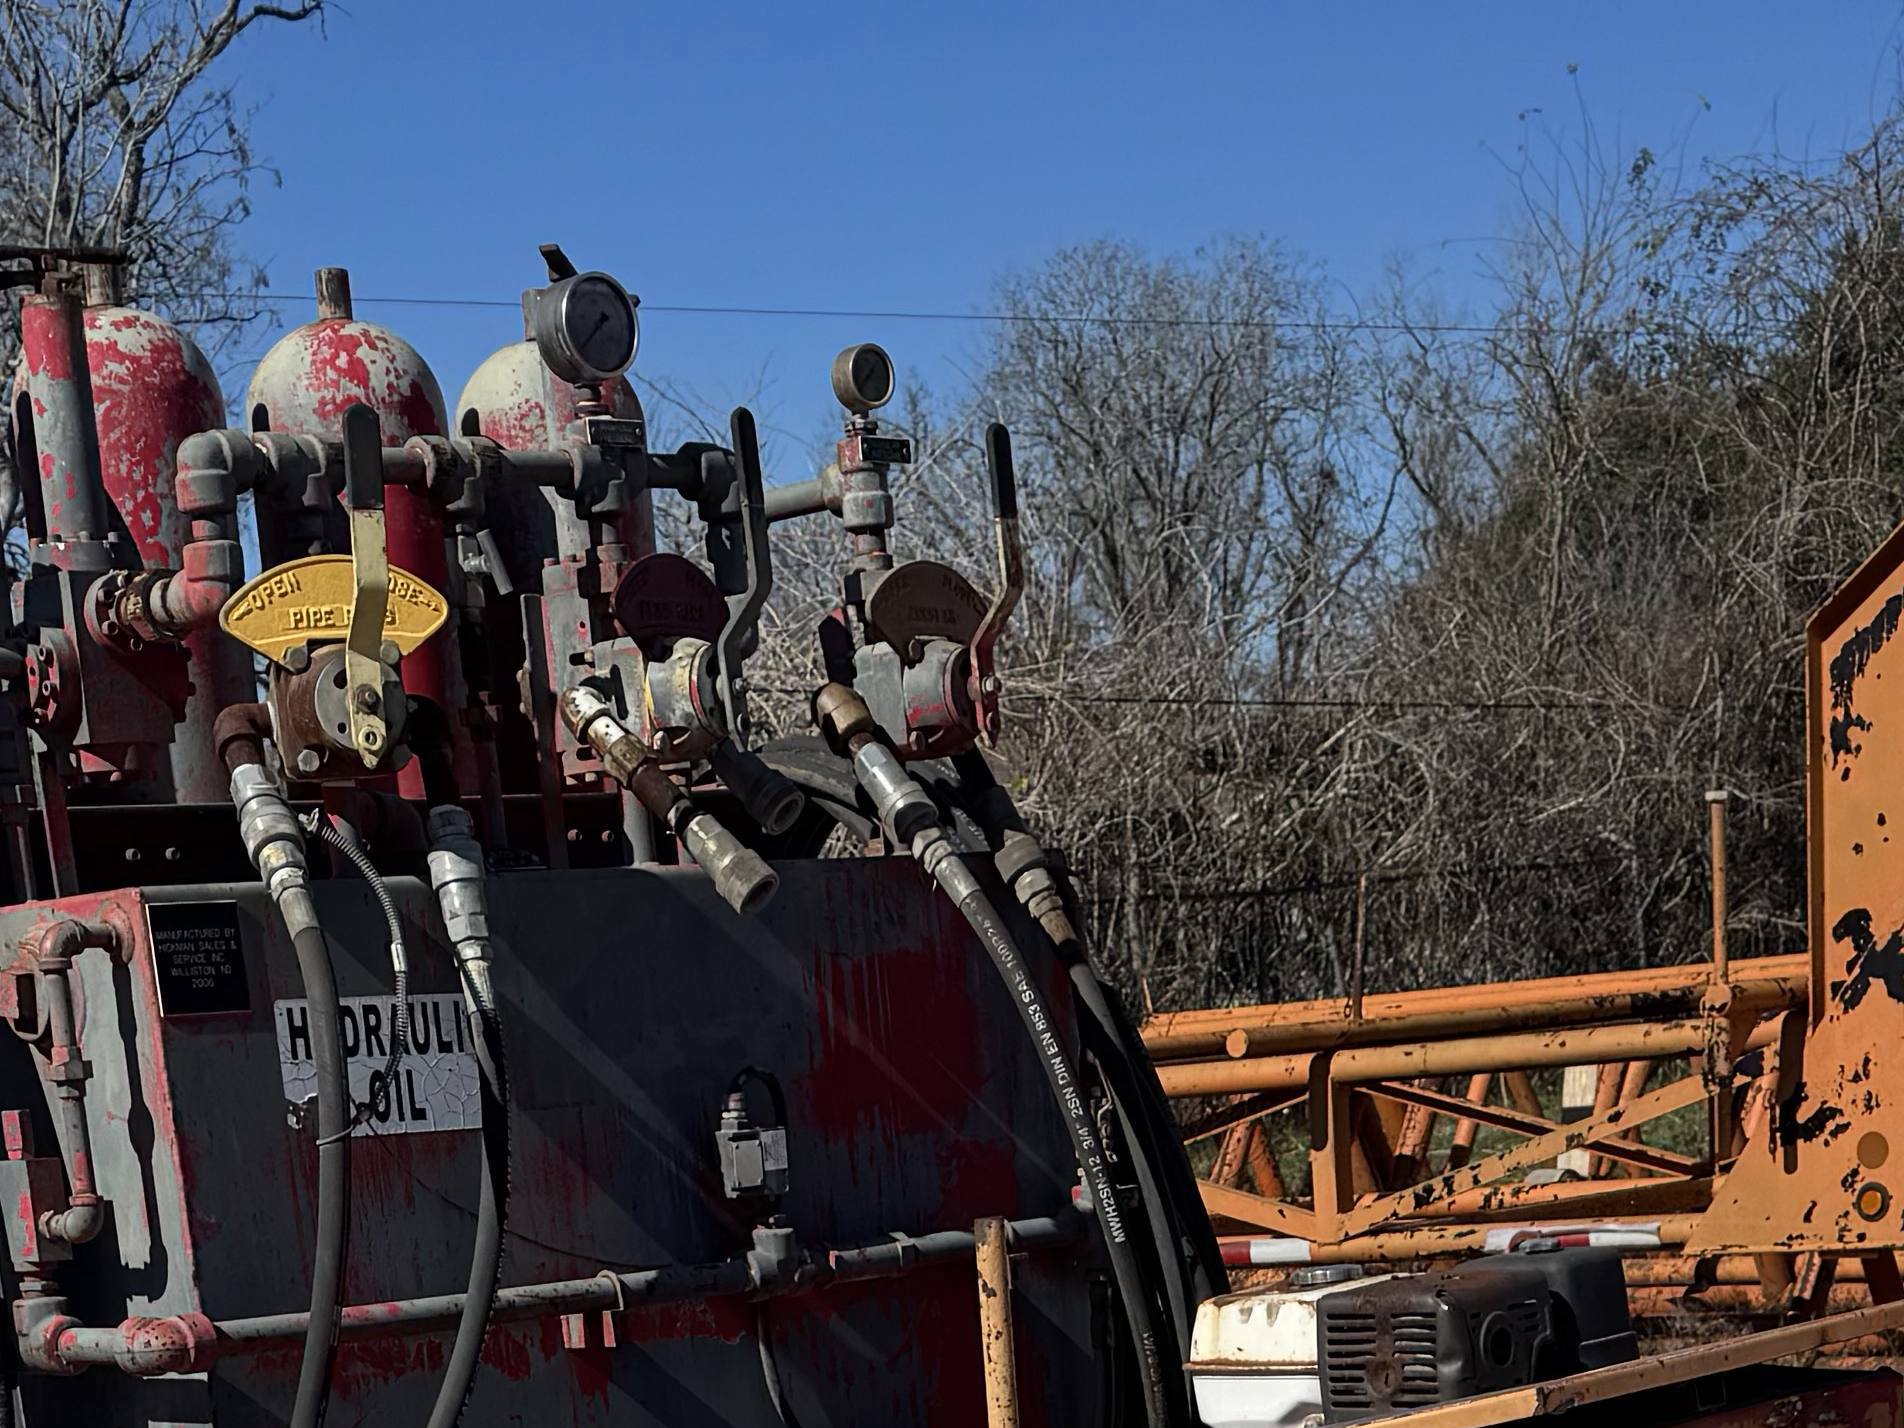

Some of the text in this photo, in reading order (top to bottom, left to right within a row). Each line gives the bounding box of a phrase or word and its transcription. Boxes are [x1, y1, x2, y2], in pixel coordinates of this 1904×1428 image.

[248, 571, 302, 610] OPEN
[289, 606, 337, 630] PIPE
[1014, 970, 1035, 1003] SAE
[286, 1000, 465, 1061] HDRAULI
[1027, 1003, 1047, 1031] 853
[1039, 1032, 1059, 1056] EN
[1051, 1056, 1070, 1085] DIN
[368, 1068, 428, 1124] OIL
[1062, 1086, 1084, 1118] 2SN
